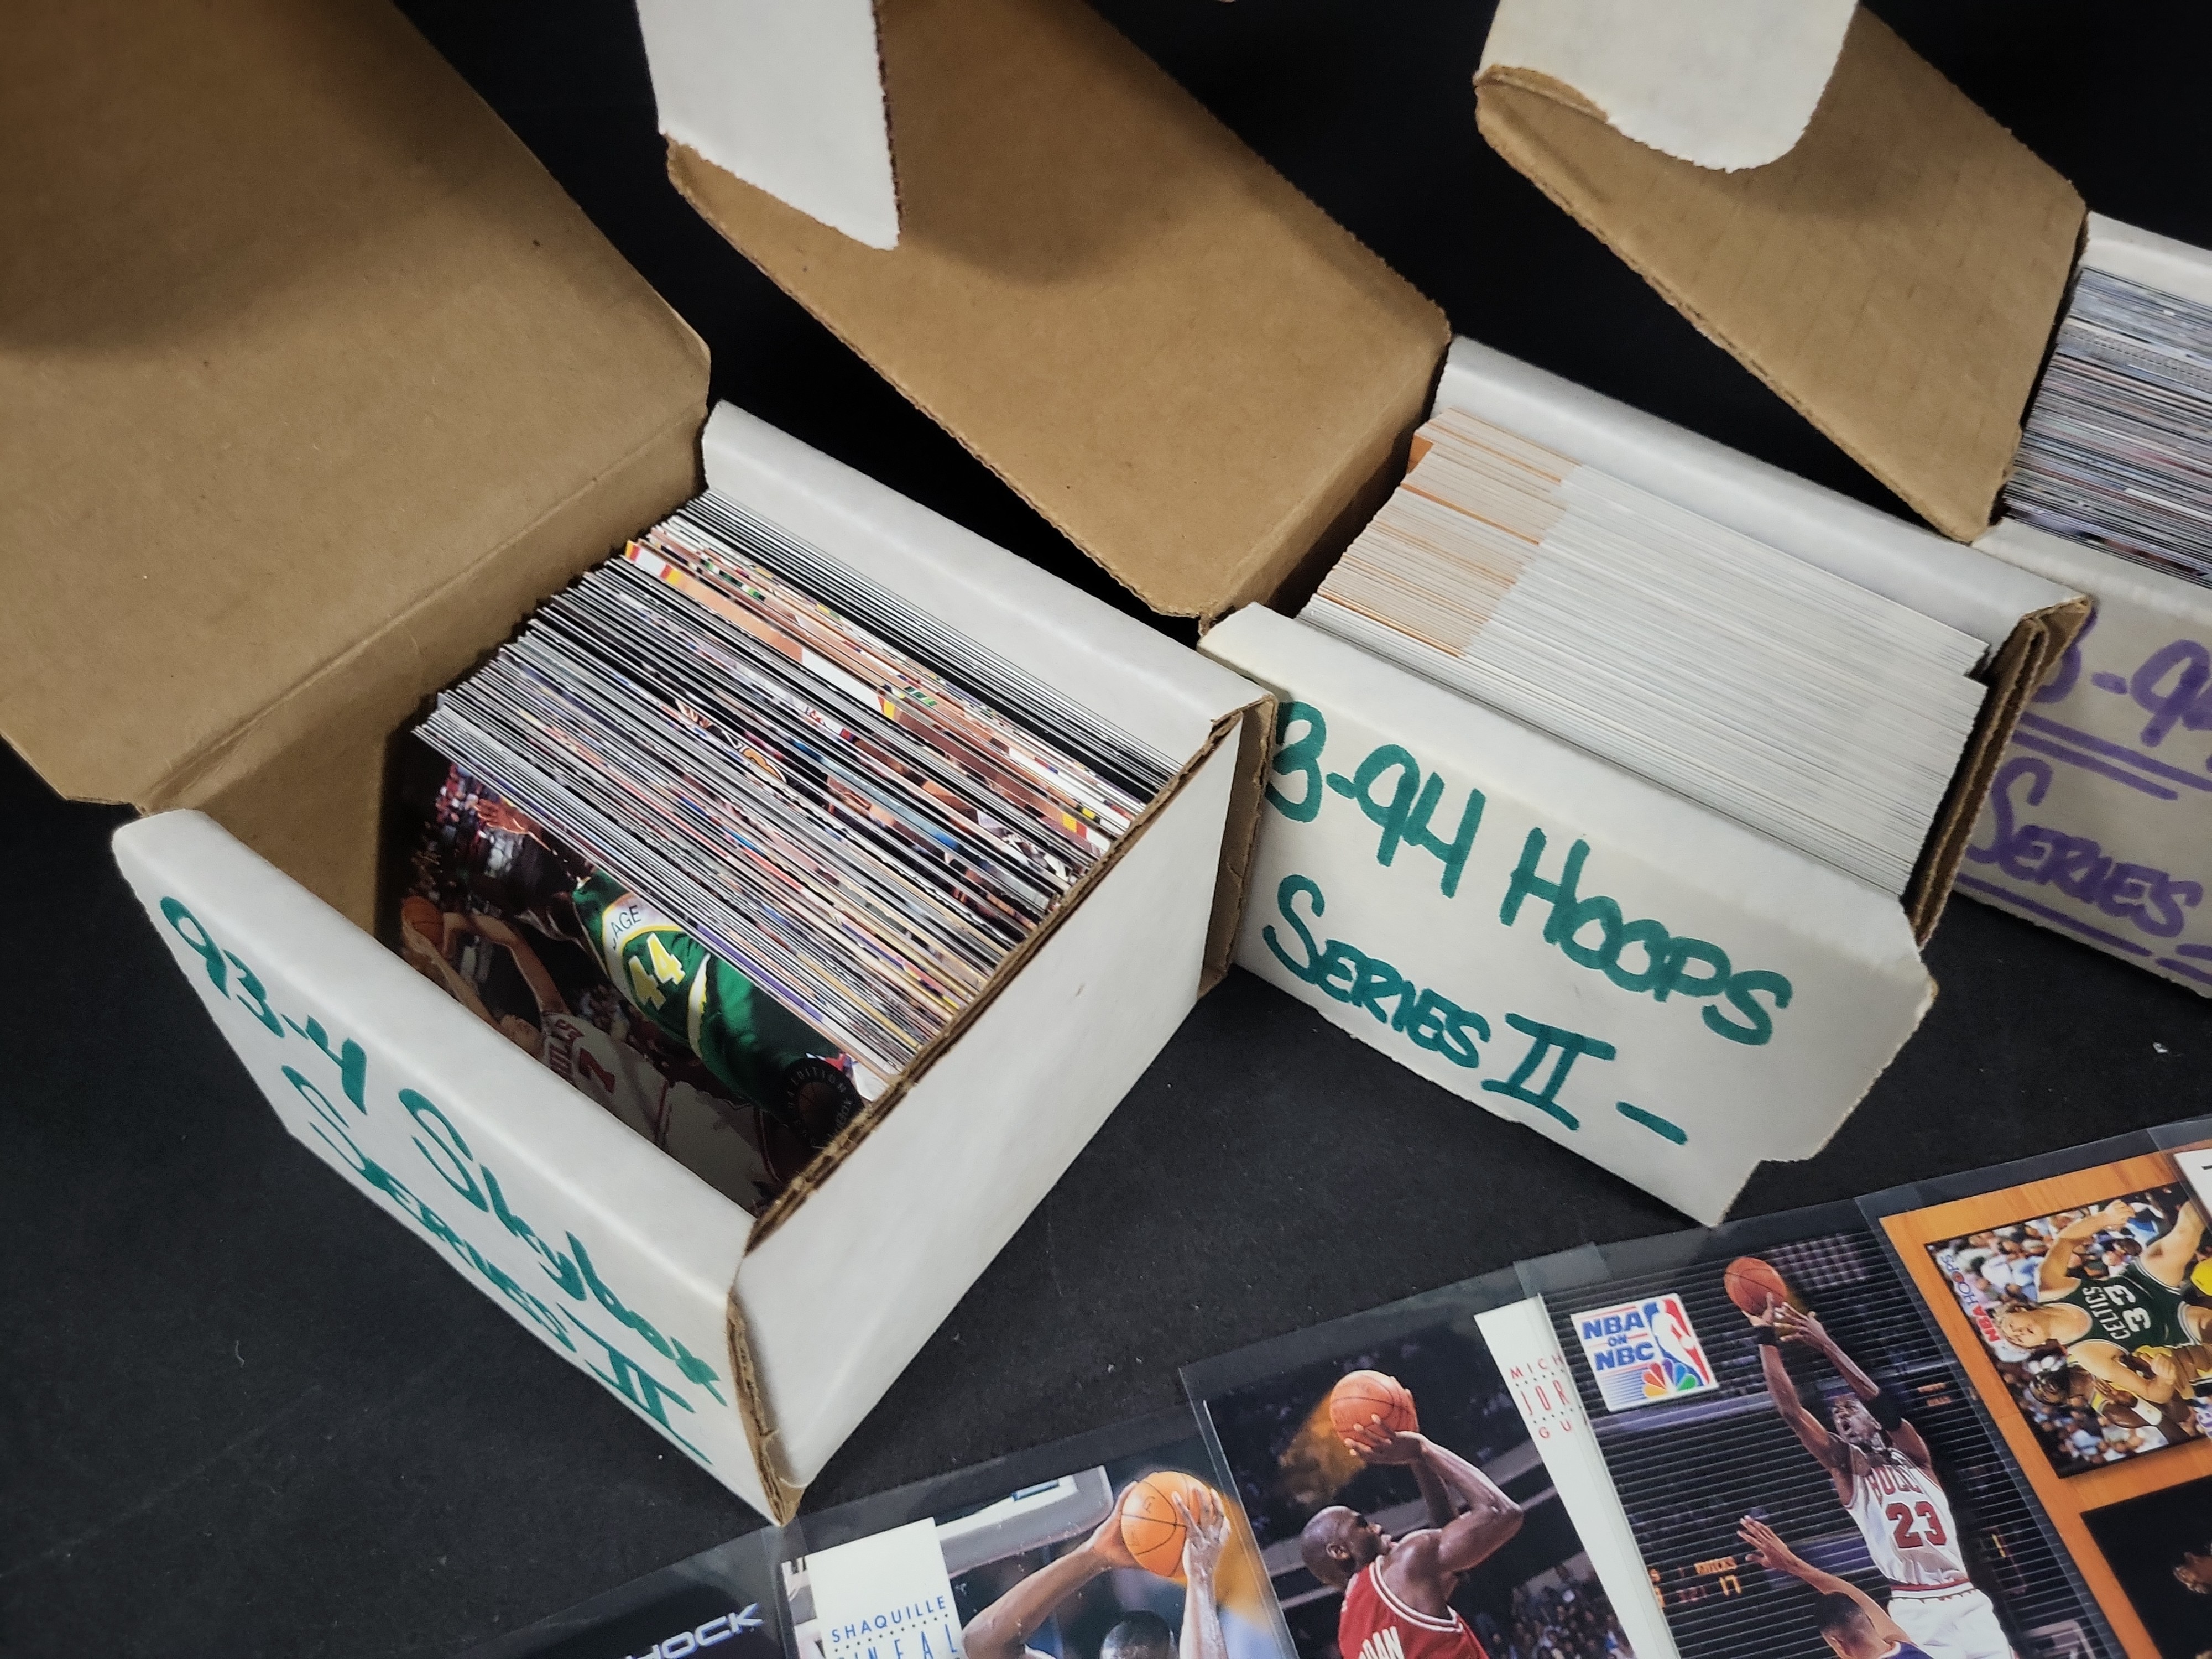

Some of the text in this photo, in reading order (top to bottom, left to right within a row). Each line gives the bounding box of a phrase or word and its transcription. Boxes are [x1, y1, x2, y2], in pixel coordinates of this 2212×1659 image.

[1499, 827, 1793, 1046] HOOPS
[628, 932, 686, 1011] 44
[1582, 1312, 1647, 1340] NBA
[1972, 1304, 2001, 1343] NBA
[2103, 1284, 2151, 1333] 33
[1594, 1342, 1656, 1371] NBC
[1608, 1334, 1629, 1347] ON
[1886, 1500, 1948, 1549] 23
[831, 1595, 946, 1643] SHAQUILLE
